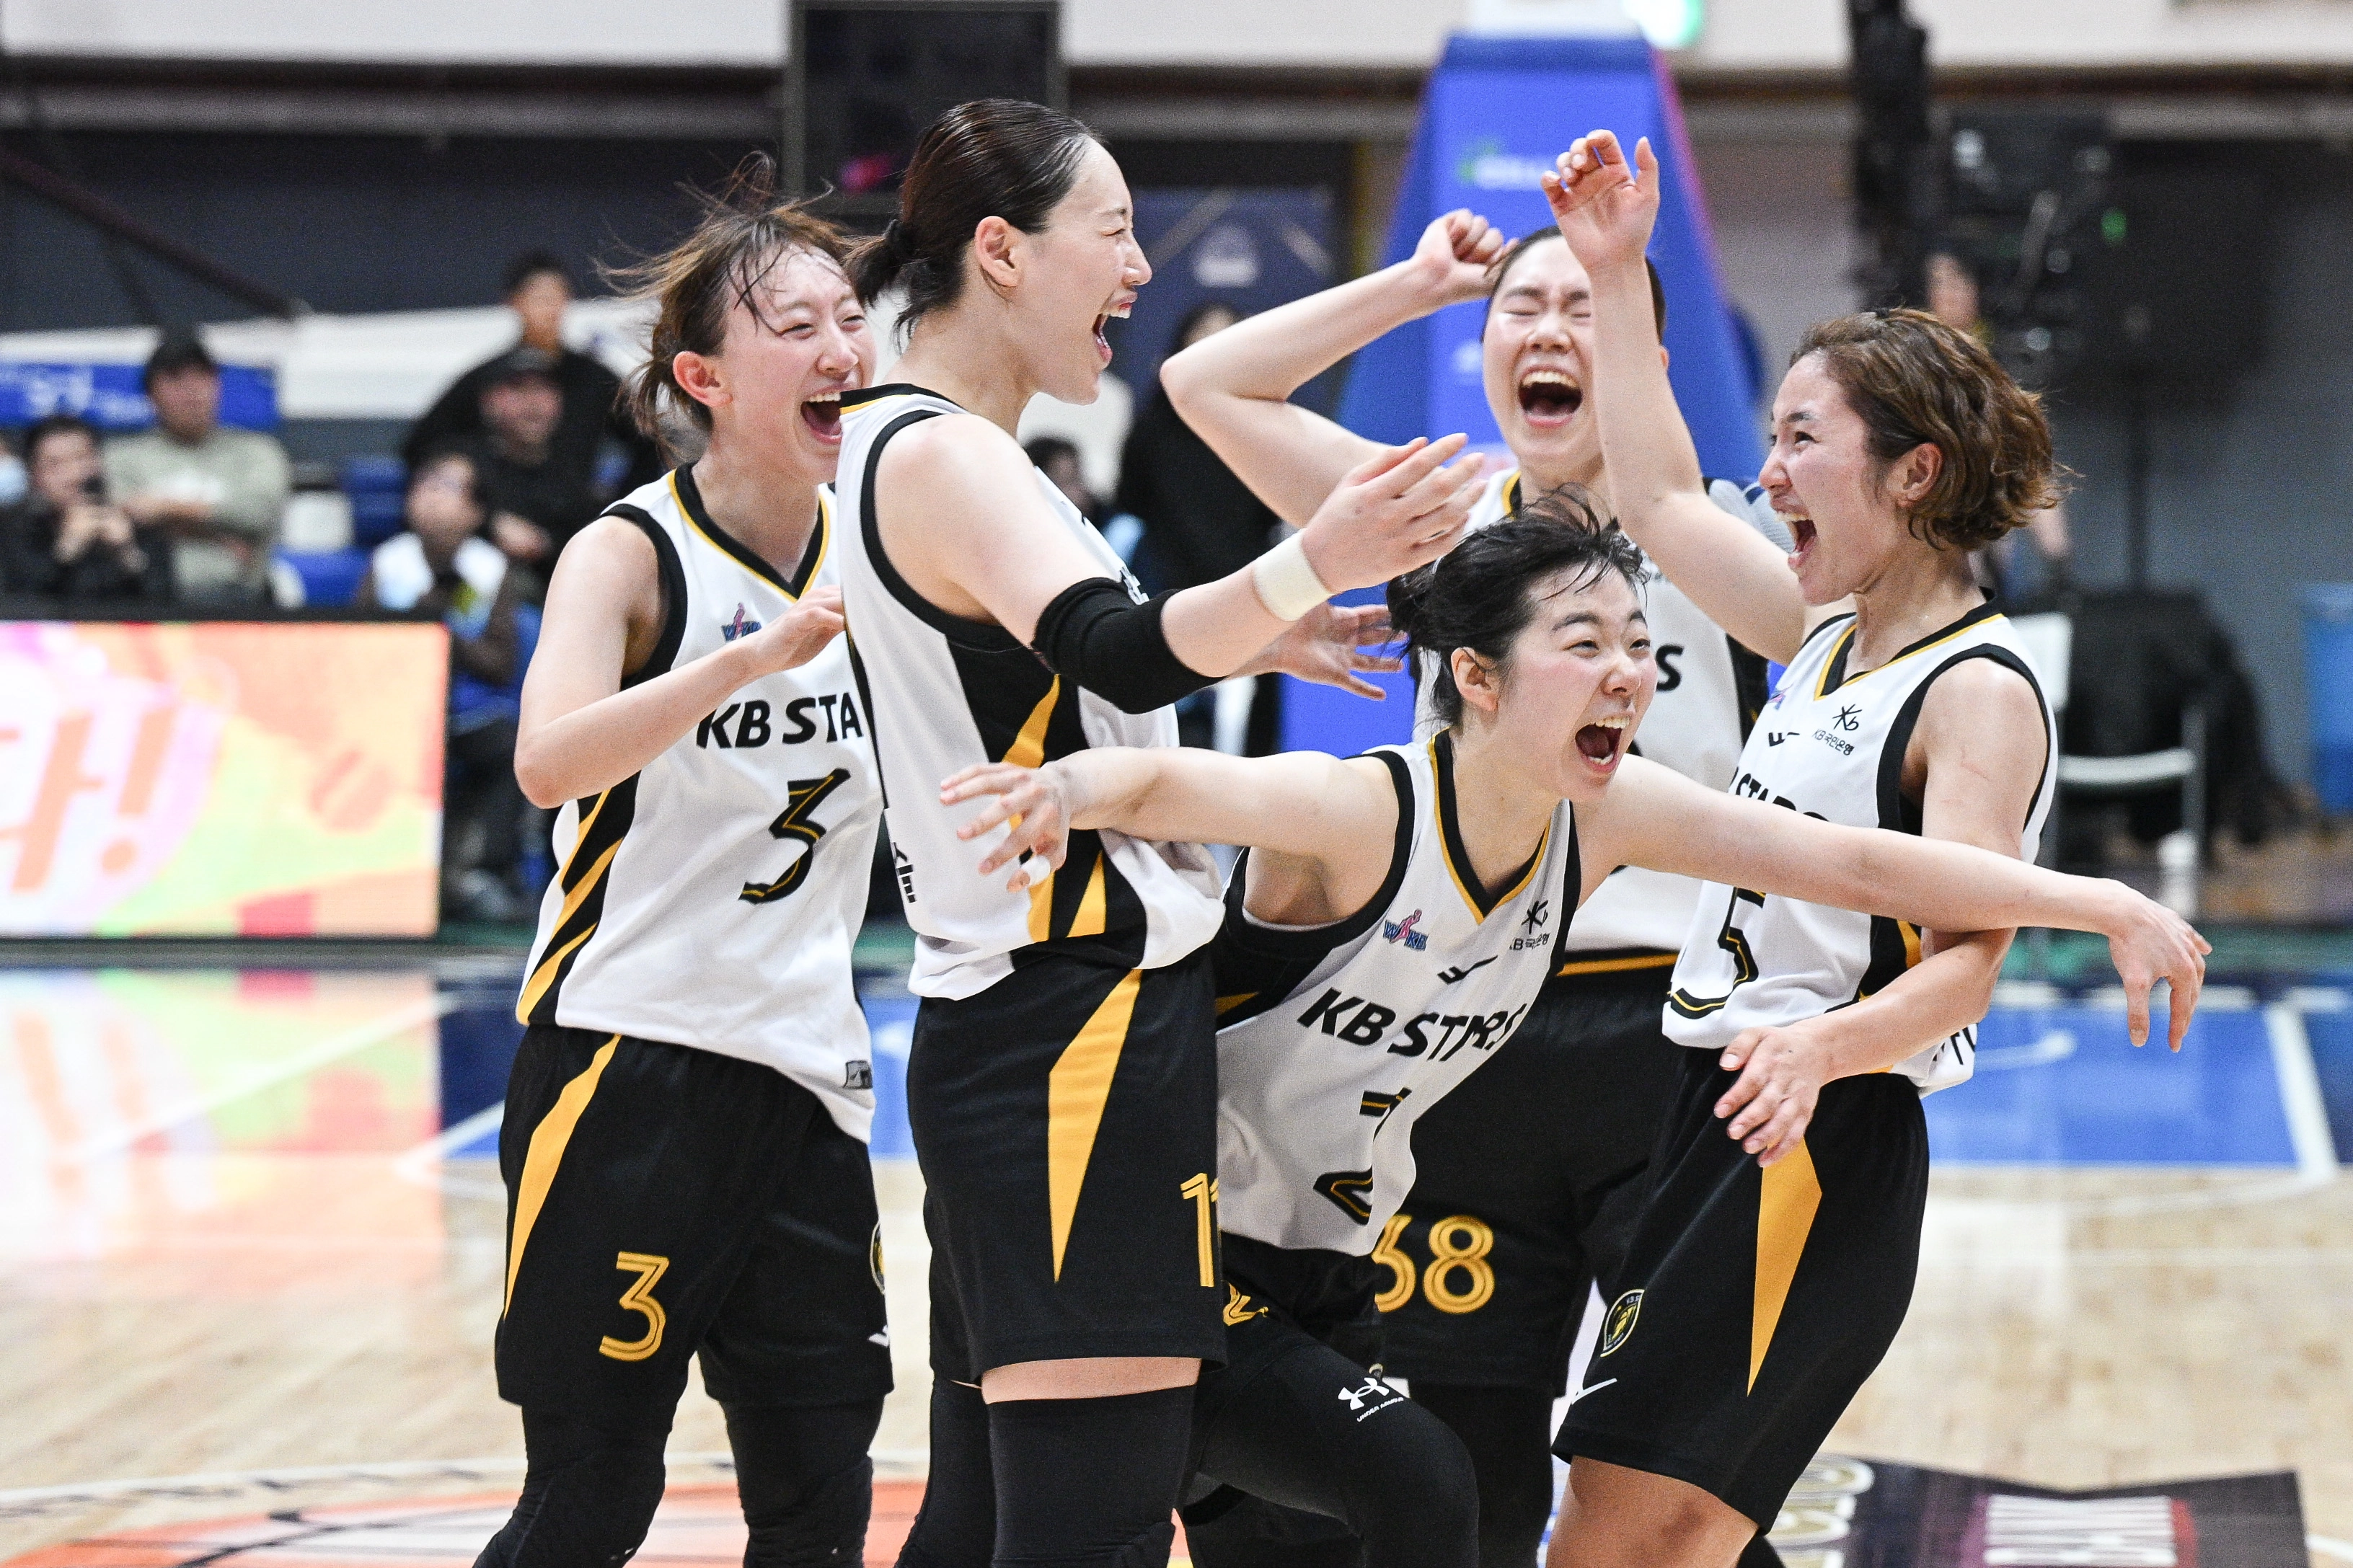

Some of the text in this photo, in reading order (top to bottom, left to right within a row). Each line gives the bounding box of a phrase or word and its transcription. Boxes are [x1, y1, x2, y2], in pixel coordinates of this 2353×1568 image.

[696, 699, 771, 749] KB
[738, 769, 851, 904] 3
[1297, 987, 1397, 1046] KB
[599, 1251, 670, 1362] 3
[1371, 1214, 1496, 1314] 38
